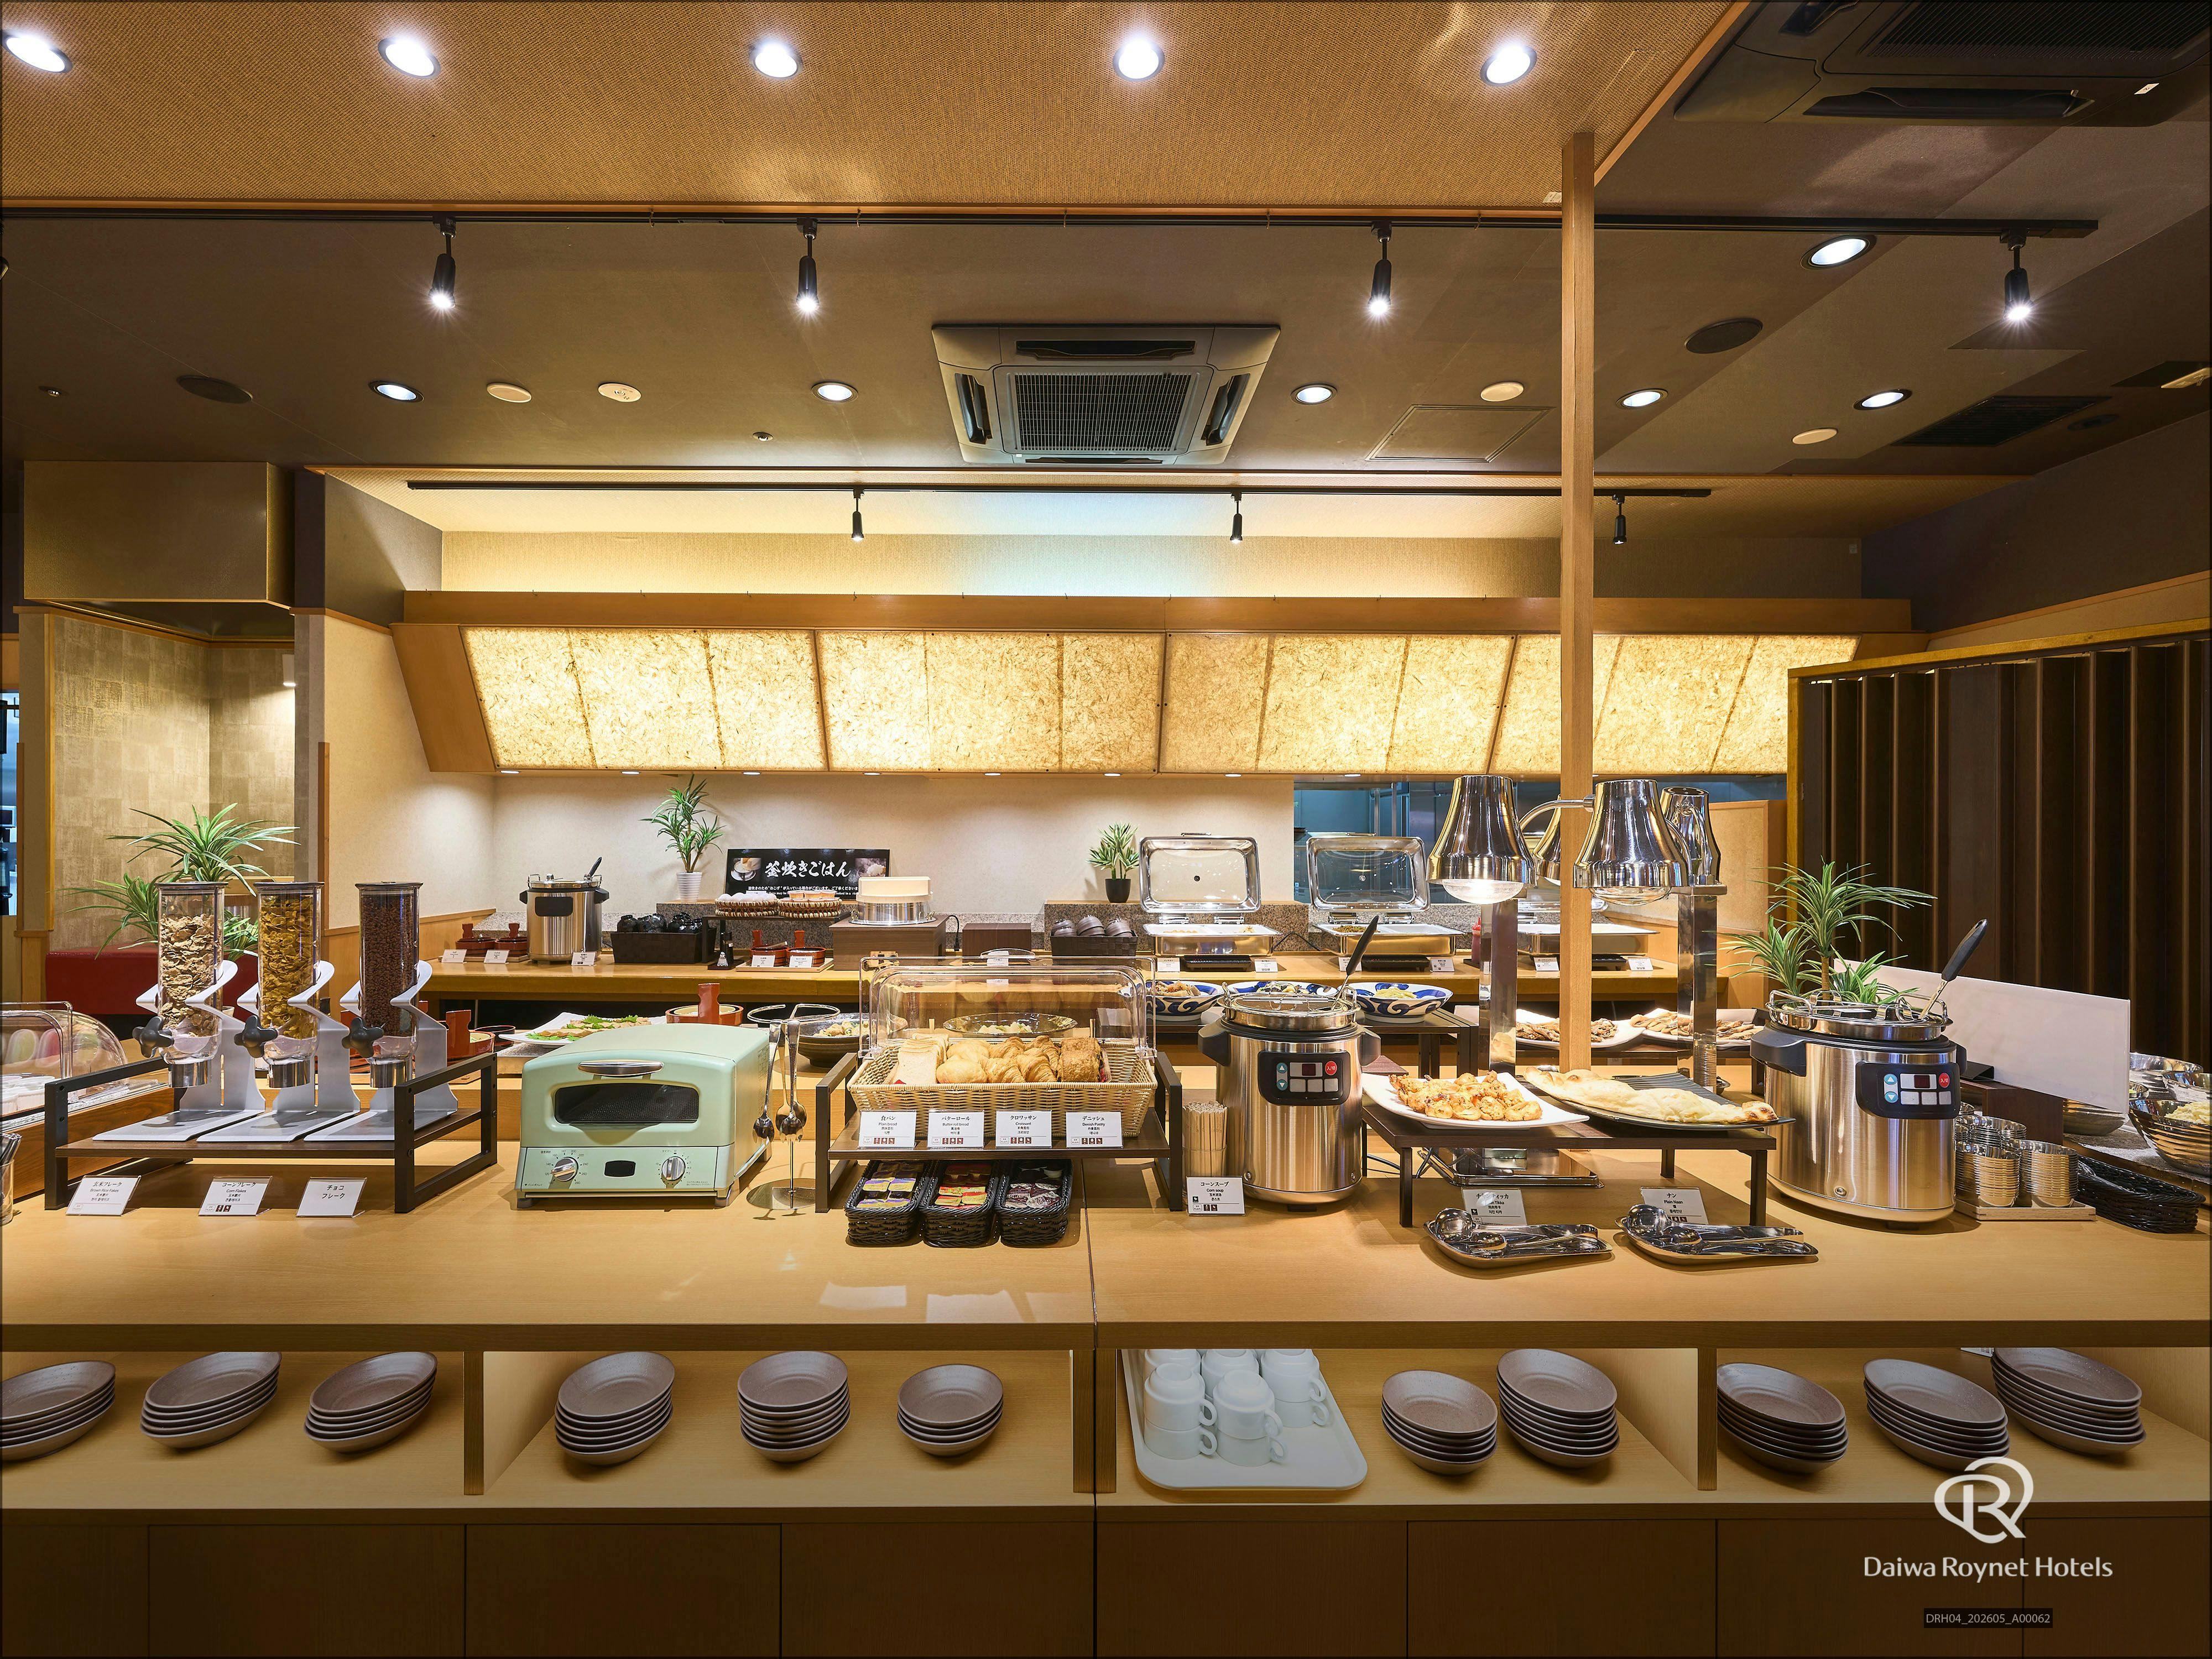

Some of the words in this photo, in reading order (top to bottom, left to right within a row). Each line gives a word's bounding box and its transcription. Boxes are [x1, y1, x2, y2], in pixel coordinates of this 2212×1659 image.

[764, 860, 851, 878] 釜炊きごはん
